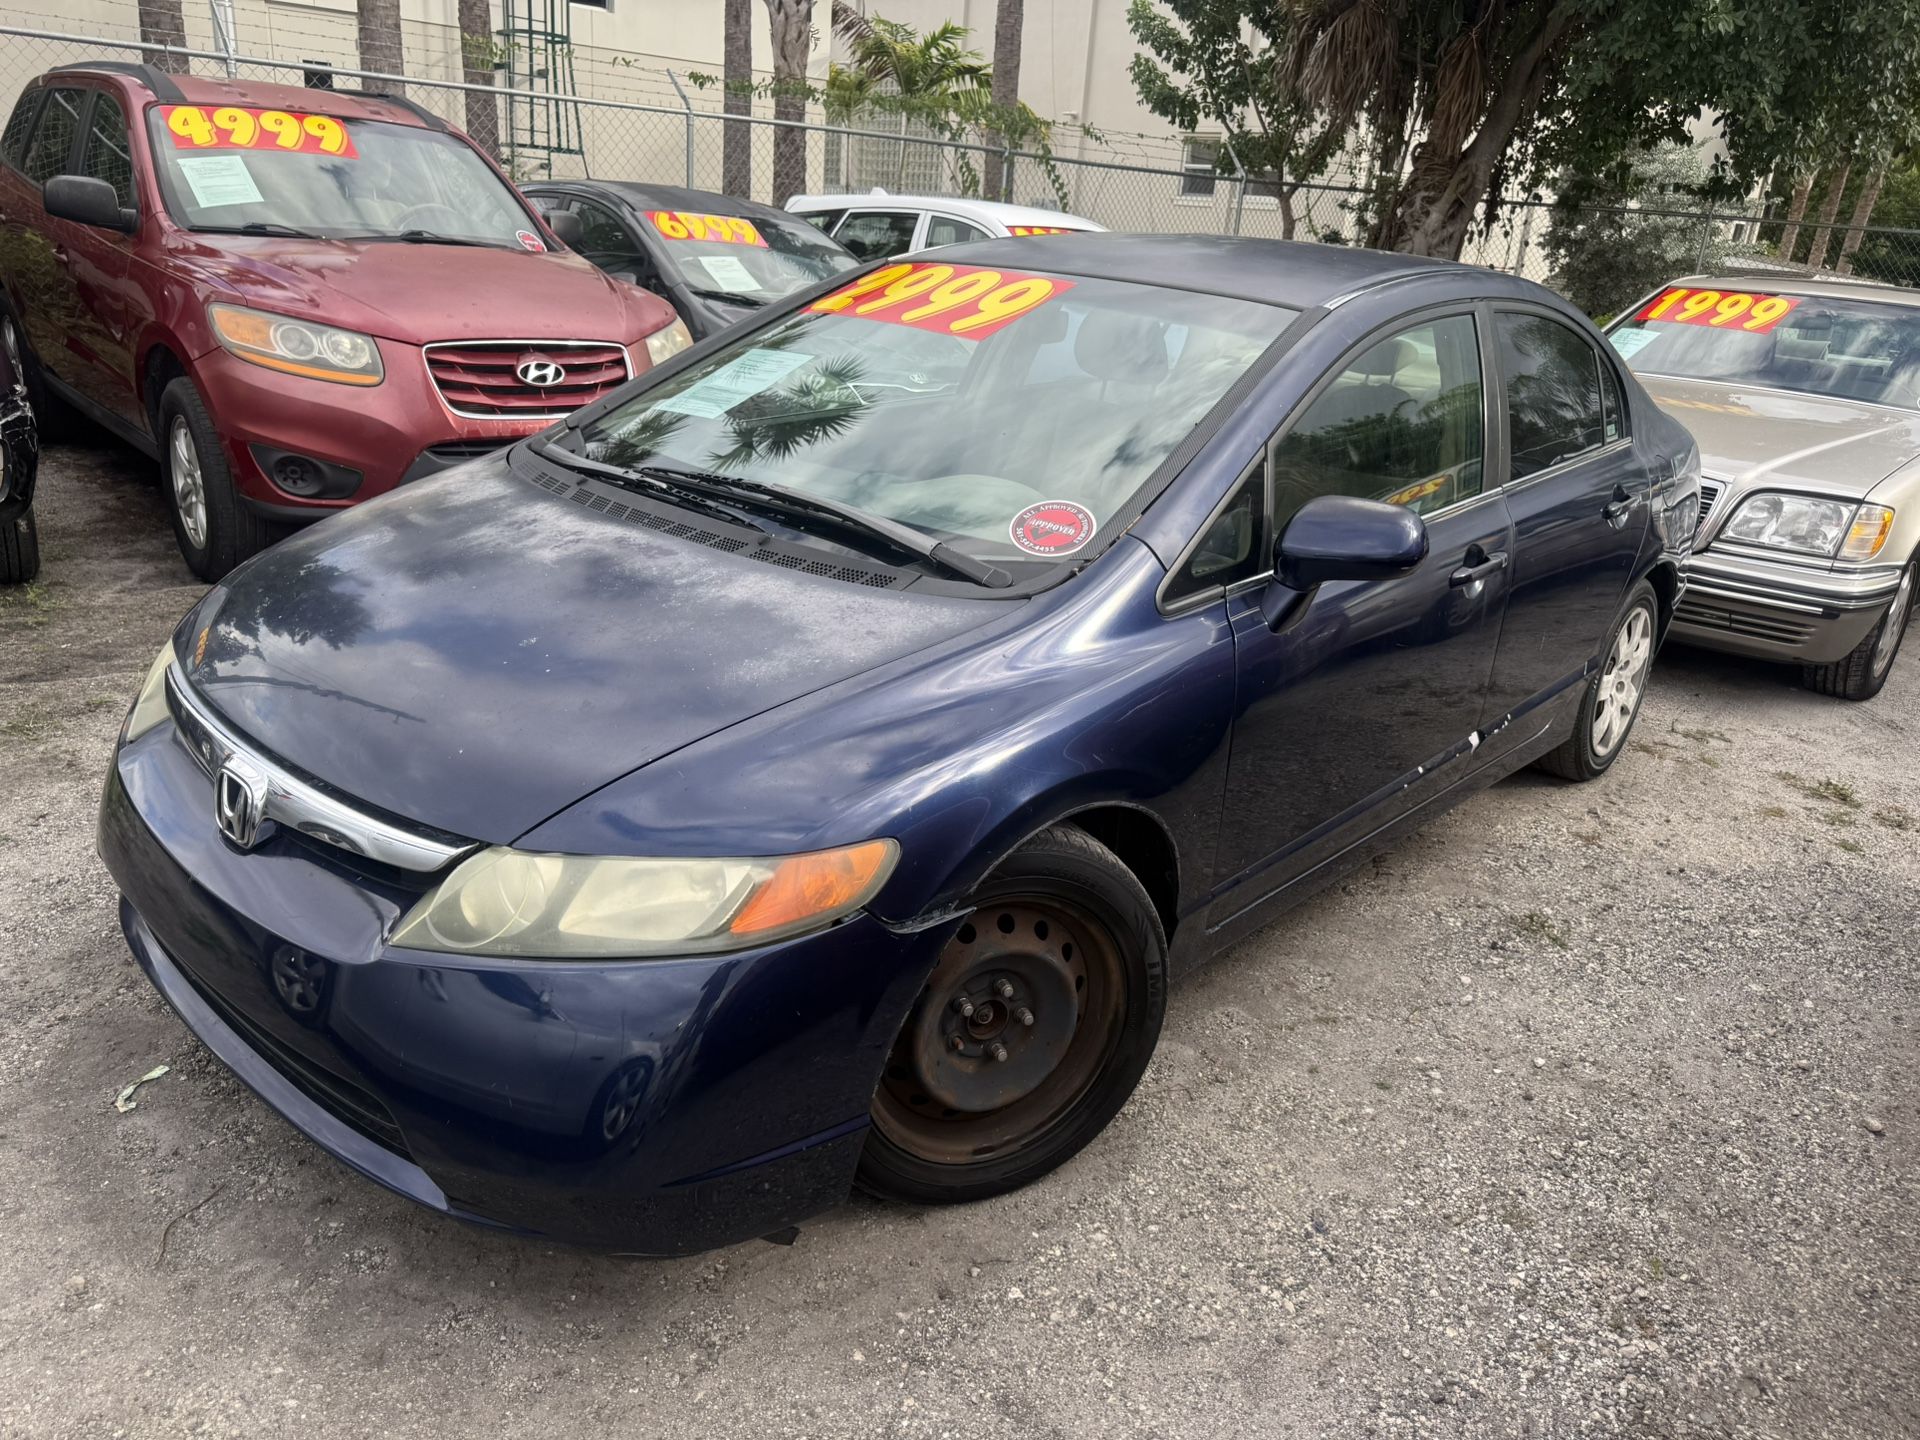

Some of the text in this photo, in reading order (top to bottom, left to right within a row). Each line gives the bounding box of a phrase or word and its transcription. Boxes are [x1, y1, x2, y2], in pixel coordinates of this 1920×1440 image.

[168, 106, 349, 155] 4999
[654, 211, 758, 245] 6999
[811, 263, 1055, 333] 2999
[1648, 289, 1791, 331] 1999
[1028, 518, 1076, 536] APPROVED
